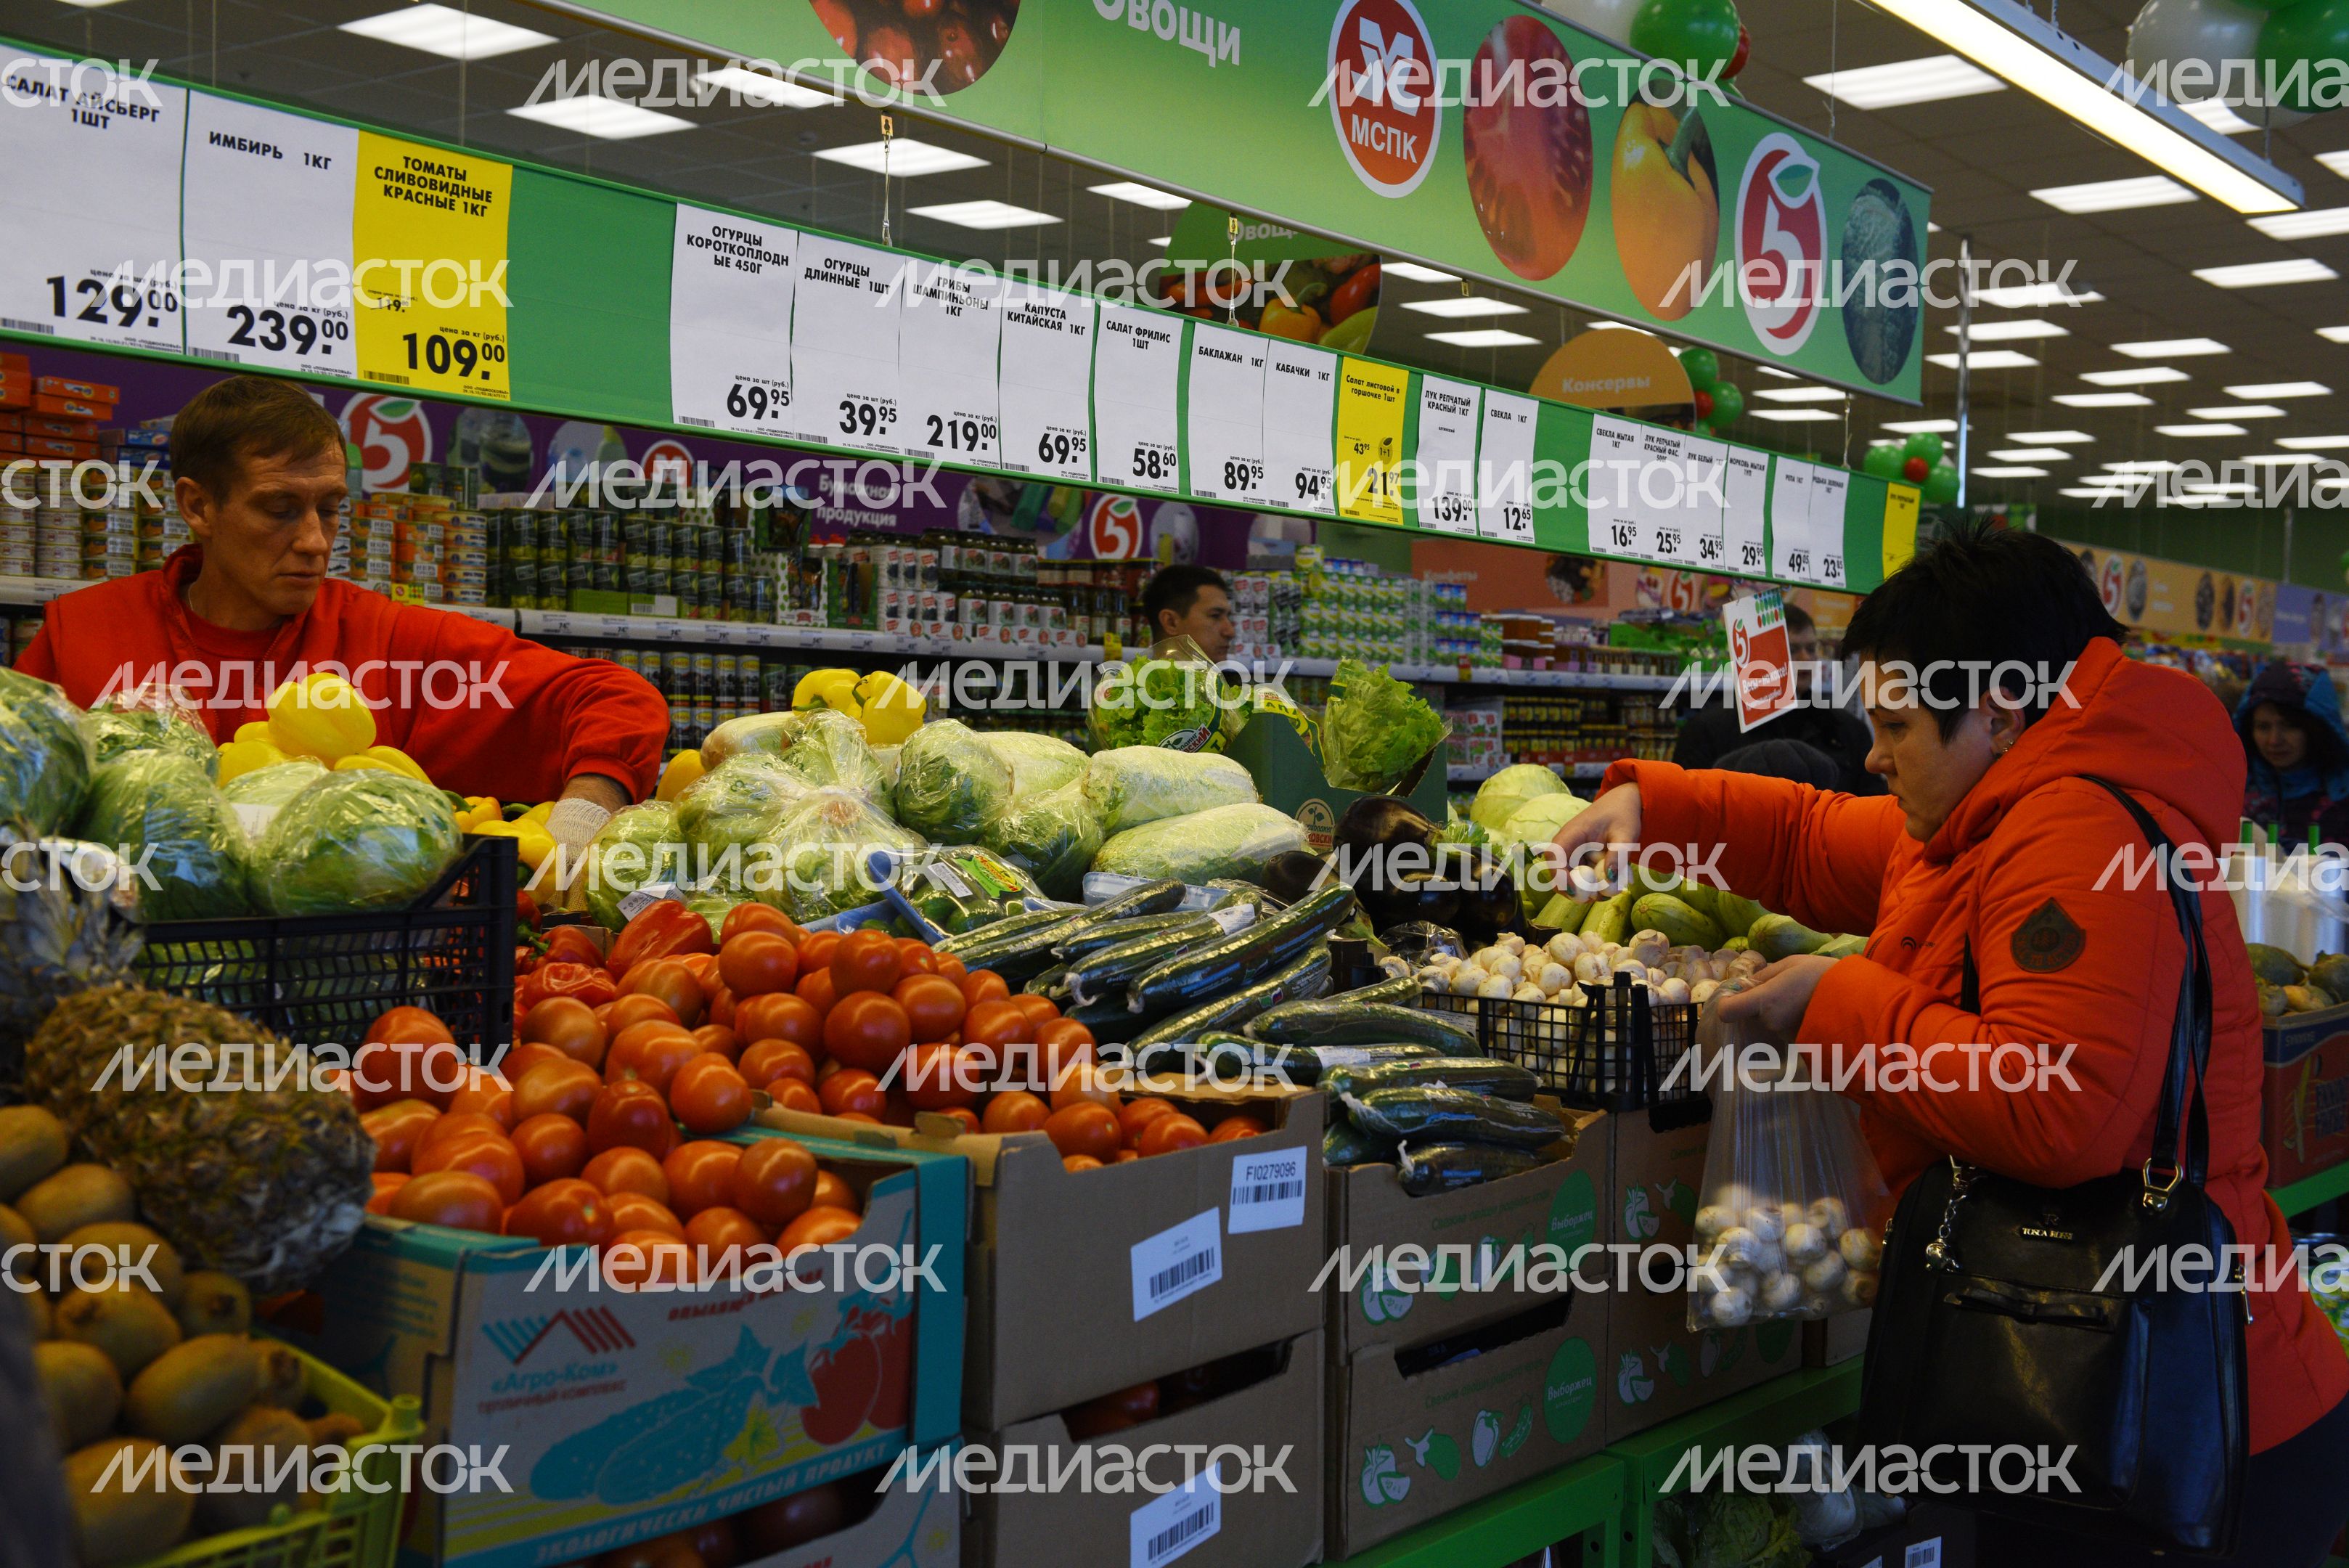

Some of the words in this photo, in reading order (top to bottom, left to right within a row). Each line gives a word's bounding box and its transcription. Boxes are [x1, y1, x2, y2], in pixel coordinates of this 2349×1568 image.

[6, 75, 69, 102] САЛАТ
[75, 91, 160, 122] АЙСБЕРГ
[72, 109, 110, 129] 1ШТ
[1351, 115, 1418, 164] МСПК
[209, 131, 283, 159] ИМБИРЬ
[303, 152, 332, 171] 1КГ
[403, 155, 467, 182] ТОМАТЫ
[374, 166, 493, 204] СЛИВОВИДНЫЕ
[383, 184, 456, 212] КРАСНЫЕ
[462, 200, 489, 218] 1КГ
[712, 225, 763, 247] ОГУРЦЫ
[687, 234, 790, 266] КОРОТКОПЛОДН
[714, 254, 731, 269] ЫЕ
[735, 258, 763, 275] 450Г
[824, 258, 870, 278] ОГУРЦЫ
[804, 266, 861, 290] ДЛИННЫЕ
[869, 281, 891, 295] 1ШТ
[937, 276, 971, 294] ГРИБЫ
[913, 284, 989, 311] ШАМПИНЬОНЫ
[946, 304, 963, 318] 1КГ
[1025, 302, 1066, 321] КАПУСТА
[1008, 310, 1063, 332] КИТАЙСКАЯ
[1069, 324, 1085, 336] 1КГ
[1106, 320, 1133, 335] САЛАТ
[1135, 327, 1171, 344] ФРИЛИС
[1132, 338, 1149, 351] 1ШТ
[1198, 346, 1243, 364] БАКЛАЖАН
[1251, 358, 1264, 368] 1КГ
[1275, 362, 1310, 377] КАБАЧКИ
[1318, 372, 1330, 381] 1КГ
[1346, 375, 1364, 389] Салат
[1366, 379, 1394, 393] листовой
[1561, 376, 1651, 393] Консервы
[1351, 386, 1381, 400] горшочке
[1384, 393, 1395, 403] 1шт
[1424, 390, 1437, 401] ЛУК
[1439, 393, 1471, 407] РЕПЧАТЫЙ
[1427, 400, 1456, 415] КРАСНЫЙ
[1458, 407, 1469, 417] 1КГ
[1490, 409, 1512, 421] СВЕКЛА
[1517, 414, 1528, 423] 1КГ
[1596, 428, 1615, 439] СВЕКЛА
[1617, 432, 1634, 443] МЫТАЯ
[1611, 440, 1621, 449] 1КГ
[1656, 436, 1680, 449] РЕПЧАТЫЙ
[1644, 443, 1667, 455] КРАСНЫЙ
[1688, 452, 1697, 461] ЛУК
[1698, 454, 1713, 465] БЕЛЫЙ
[1730, 457, 1749, 467] МОРКОВЬ
[1750, 462, 1765, 471] МЫТАЯ
[817, 507, 896, 528] продукция
[1246, 1161, 1296, 1182] FI0279096
[1551, 1211, 1593, 1232] Выборжец
[1548, 1376, 1592, 1401] Выборжец
[536, 1501, 708, 1563] ЭКОЛОГИЧЕСКИ
[716, 1470, 800, 1519] ЧИСТЫЙ
[804, 1444, 888, 1485] ПРОДУКТ
